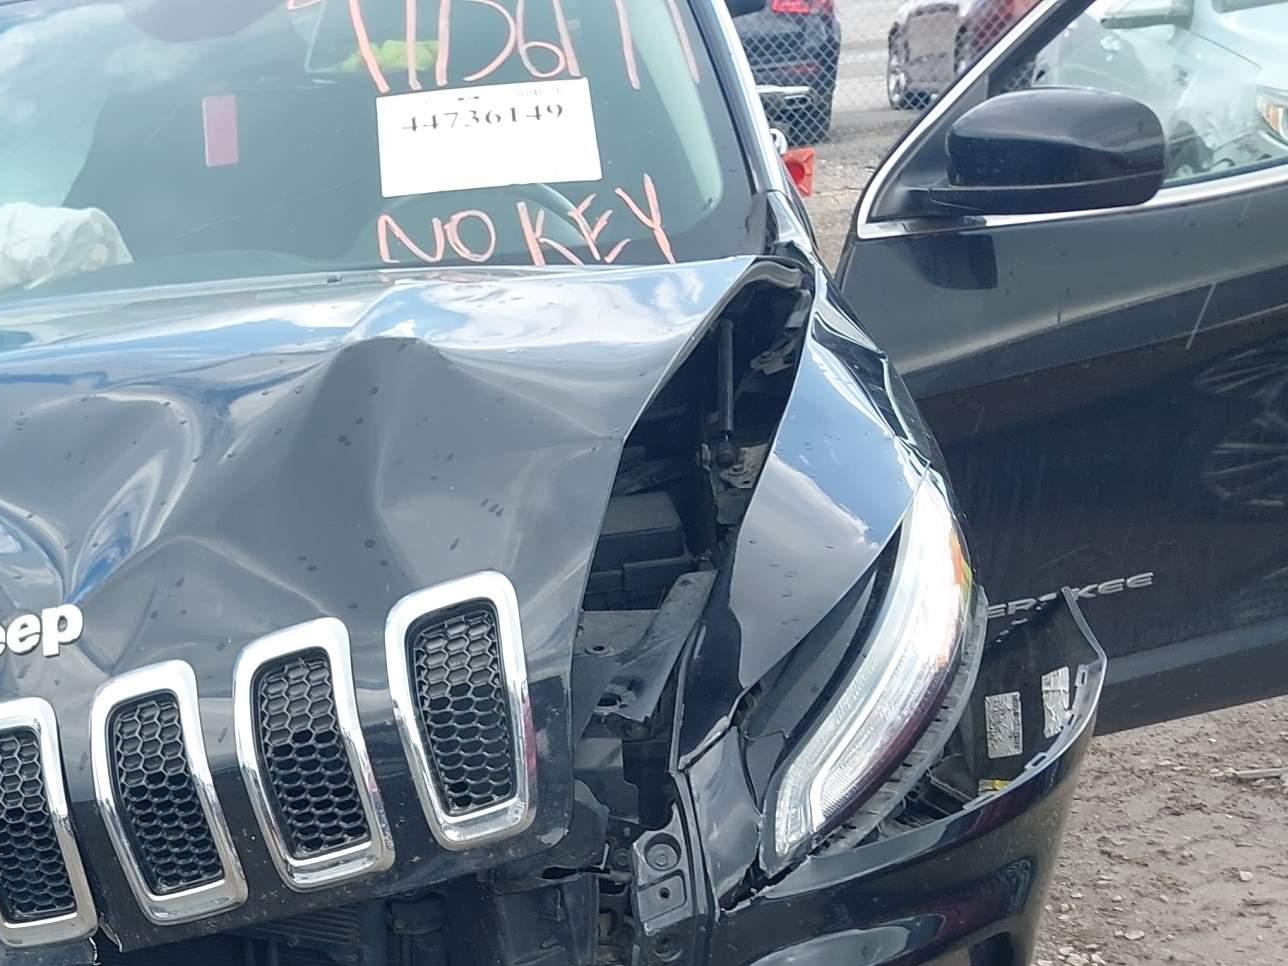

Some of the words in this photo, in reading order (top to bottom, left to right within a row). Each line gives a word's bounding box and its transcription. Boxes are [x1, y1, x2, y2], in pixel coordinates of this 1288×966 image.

[401, 103, 564, 132] 44736149
[377, 209, 496, 263] NO
[515, 173, 678, 267] KEY
